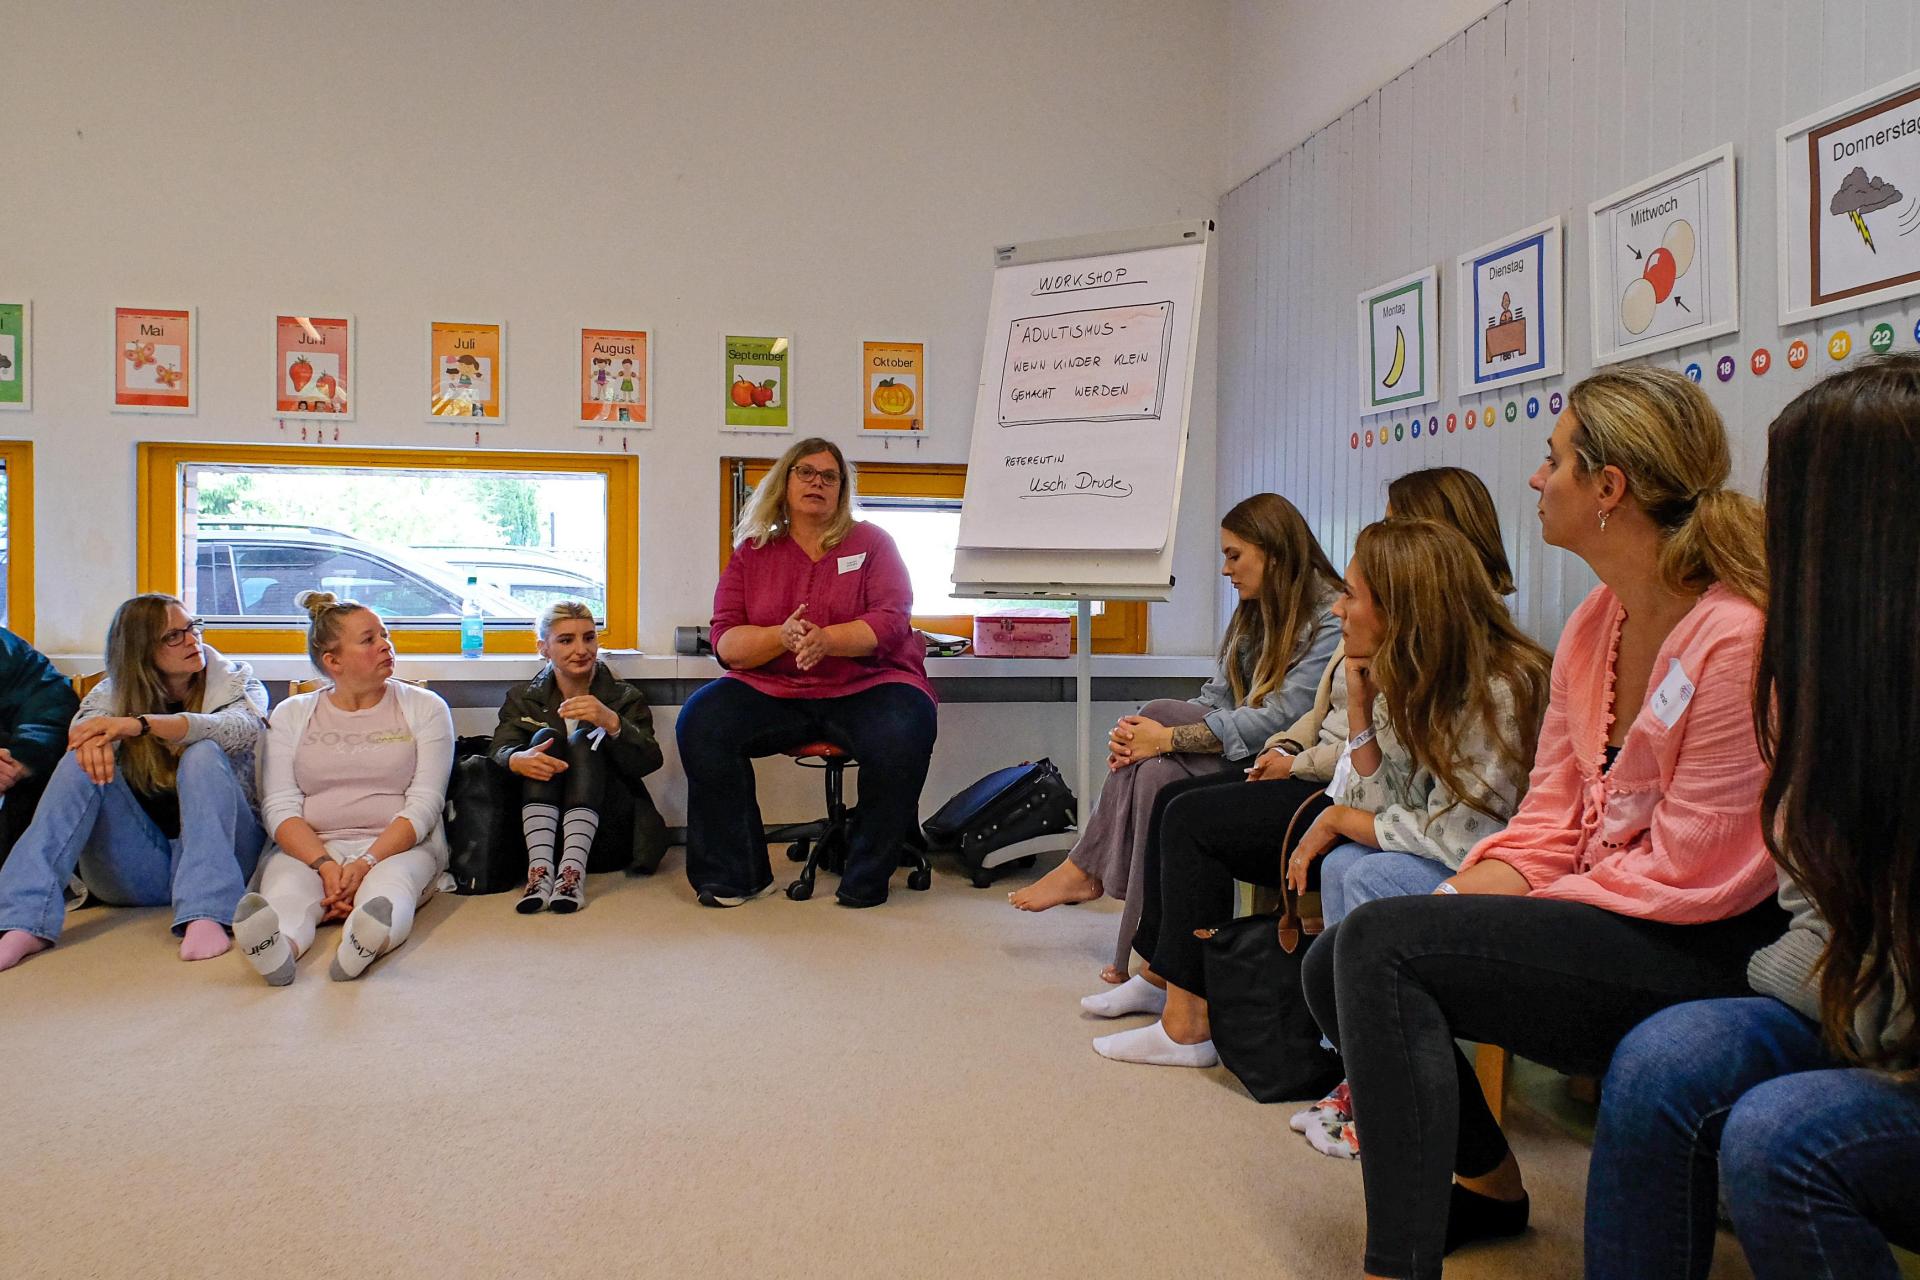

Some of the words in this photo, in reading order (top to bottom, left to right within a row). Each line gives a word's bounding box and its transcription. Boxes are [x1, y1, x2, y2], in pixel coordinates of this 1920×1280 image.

[1631, 196, 1678, 227] Mittwoch
[1489, 258, 1524, 280] Dienstag
[1039, 268, 1127, 291] WORKSHOP
[1383, 303, 1406, 318] Montag
[141, 324, 164, 337] Mai
[454, 337, 475, 350] Juli
[593, 342, 635, 356] August
[1720, 362, 1731, 375] 18
[1754, 354, 1767, 368] 19
[1789, 347, 1805, 361] 20
[1832, 338, 1846, 353] 21
[1872, 331, 1891, 346] 22
[728, 349, 785, 362] September
[873, 357, 914, 368] Oktober
[1014, 360, 1046, 372] WENN
[1054, 356, 1101, 370] KINDER
[1114, 352, 1149, 366] KLEIN
[1011, 387, 1057, 402] GEMACHT
[1074, 383, 1129, 397] WERDEN
[1507, 407, 1515, 417] 10
[1552, 398, 1560, 408] 12
[1005, 454, 1065, 467] REFERENTIN
[1029, 474, 1067, 492] Uschi
[1075, 471, 1128, 491] Drude
